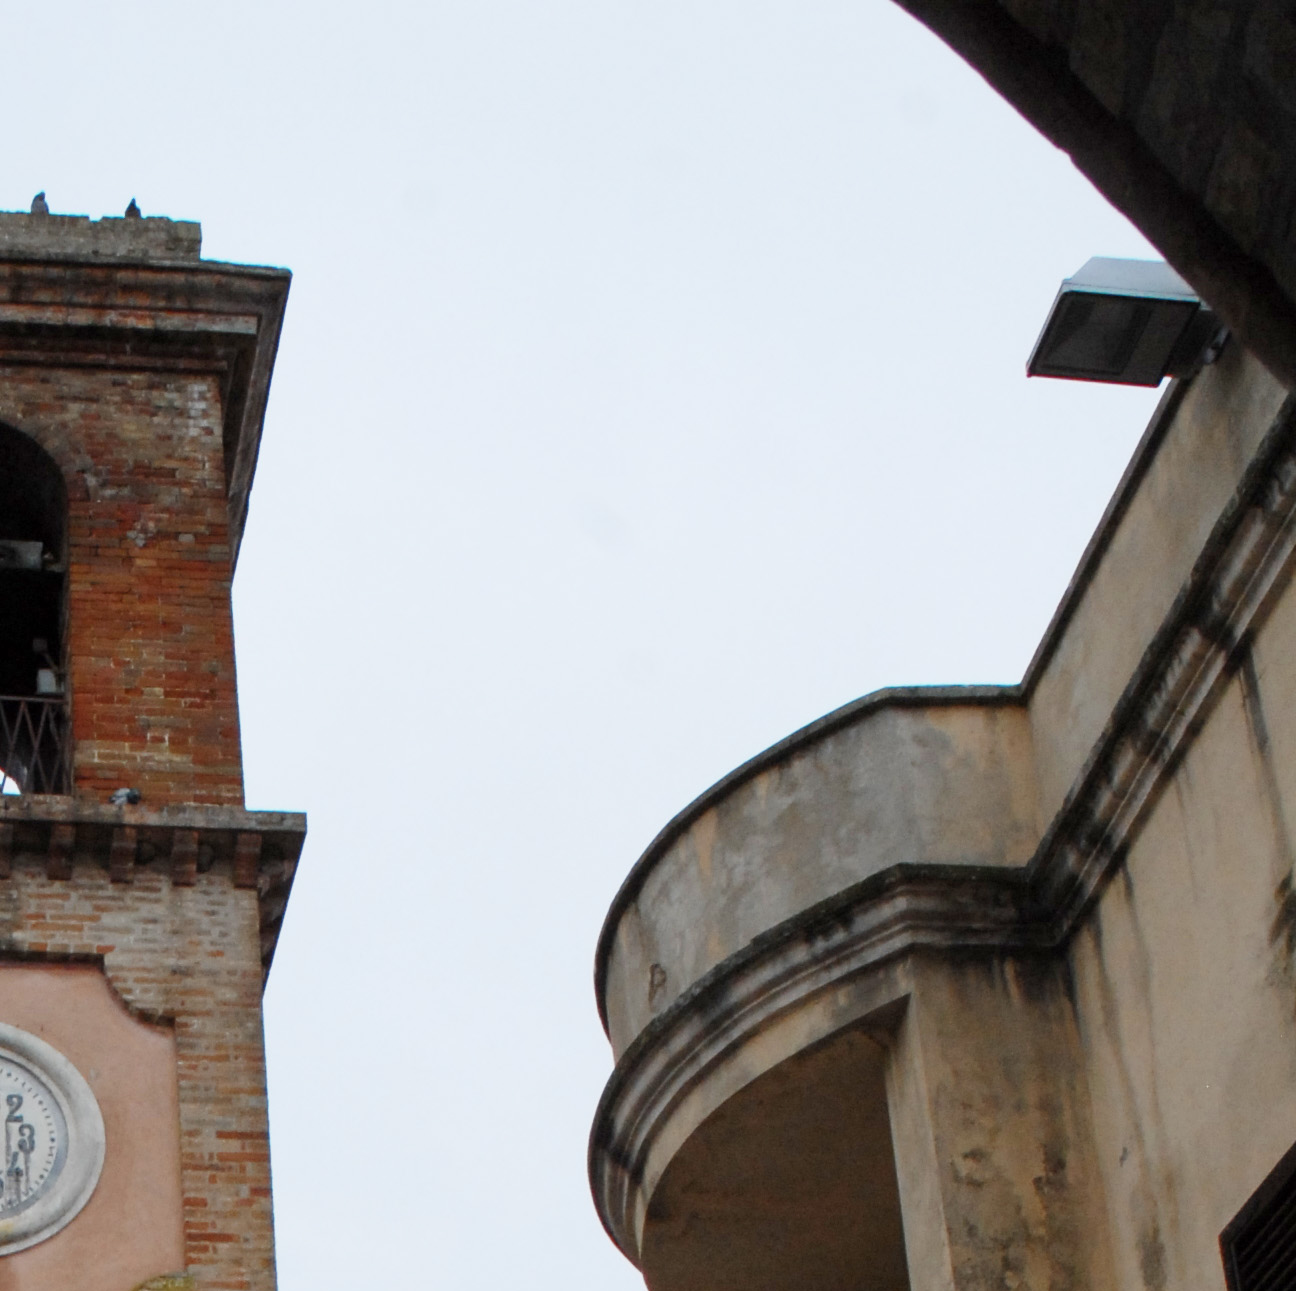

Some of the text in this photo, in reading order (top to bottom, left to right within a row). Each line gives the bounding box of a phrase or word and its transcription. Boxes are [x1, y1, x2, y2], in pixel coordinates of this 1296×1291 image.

[6, 1094, 24, 1122] 2
[18, 1123, 35, 1154] 3
[6, 1151, 24, 1180] 4
